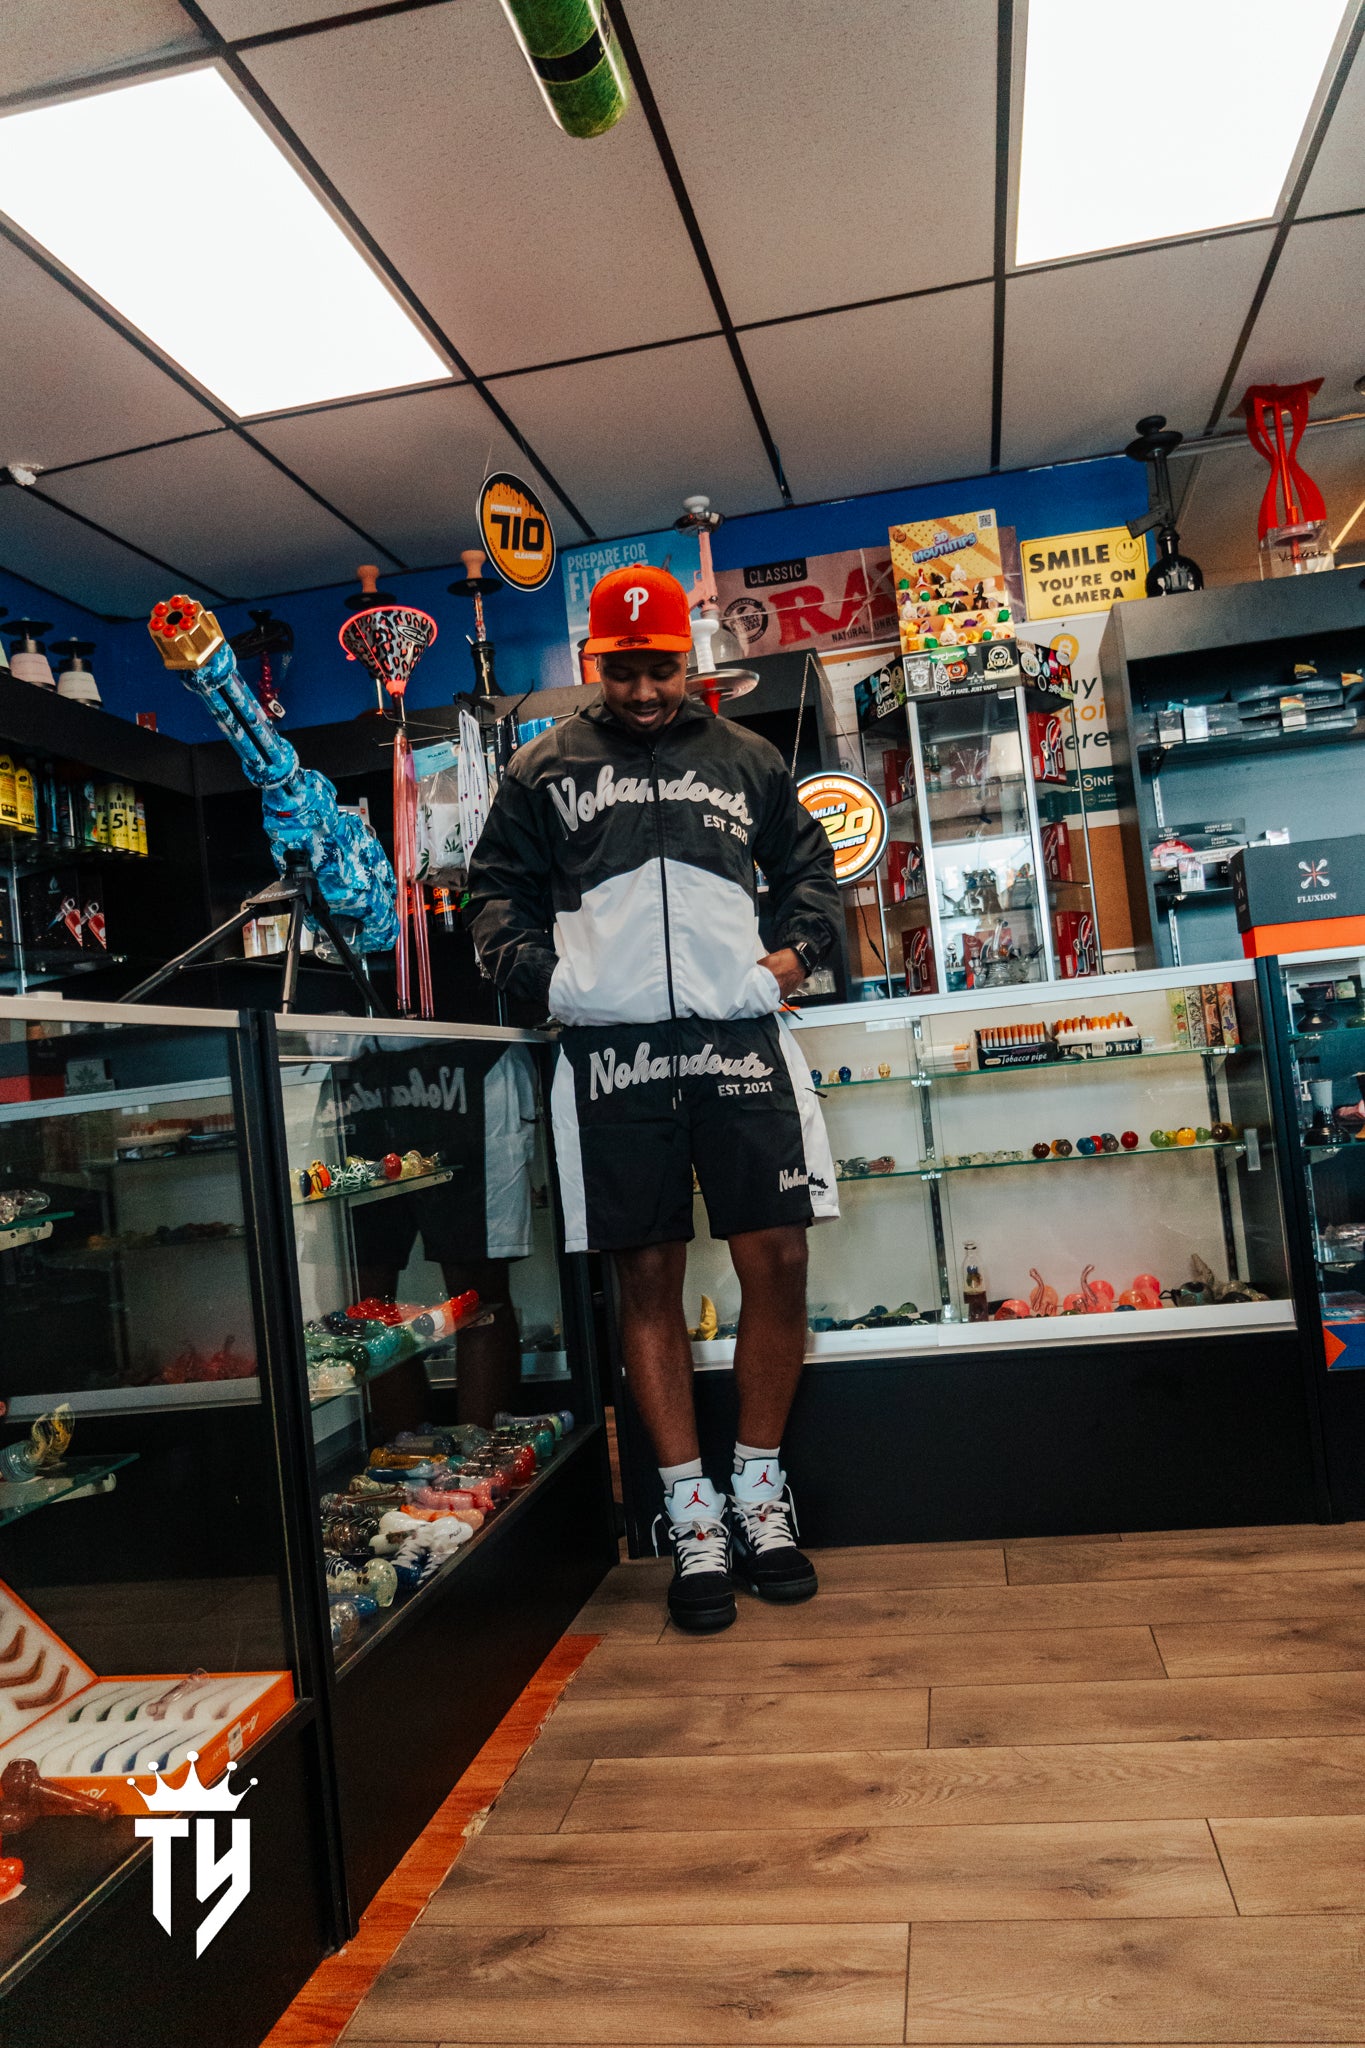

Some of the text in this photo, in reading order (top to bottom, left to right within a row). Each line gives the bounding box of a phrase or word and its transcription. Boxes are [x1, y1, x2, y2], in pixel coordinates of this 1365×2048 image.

[490, 514, 545, 551] 710
[933, 530, 949, 544] 3D
[567, 547, 621, 572] PREPARE
[622, 543, 647, 562] FOR
[912, 532, 977, 564] MOUTHTIPS
[1029, 543, 1110, 574] SMILE
[750, 564, 802, 585] CLASSIC
[1038, 568, 1136, 593] YOU'RE ON
[623, 586, 649, 622] P
[1051, 587, 1124, 607] CAMERA
[832, 616, 898, 643] NATURAL UNRE
[1064, 730, 1109, 751] ere
[1075, 774, 1115, 791] COINF
[811, 802, 846, 820] MULA
[703, 814, 748, 846] EST 2021
[819, 806, 874, 843] 20
[834, 835, 866, 851] EANERS
[1297, 892, 1337, 904] FLUXION
[589, 1041, 774, 1101] Nohandouts
[998, 1053, 1030, 1066] Tobacco
[1031, 1053, 1047, 1064] pipe
[717, 1081, 773, 1097] EST 2021
